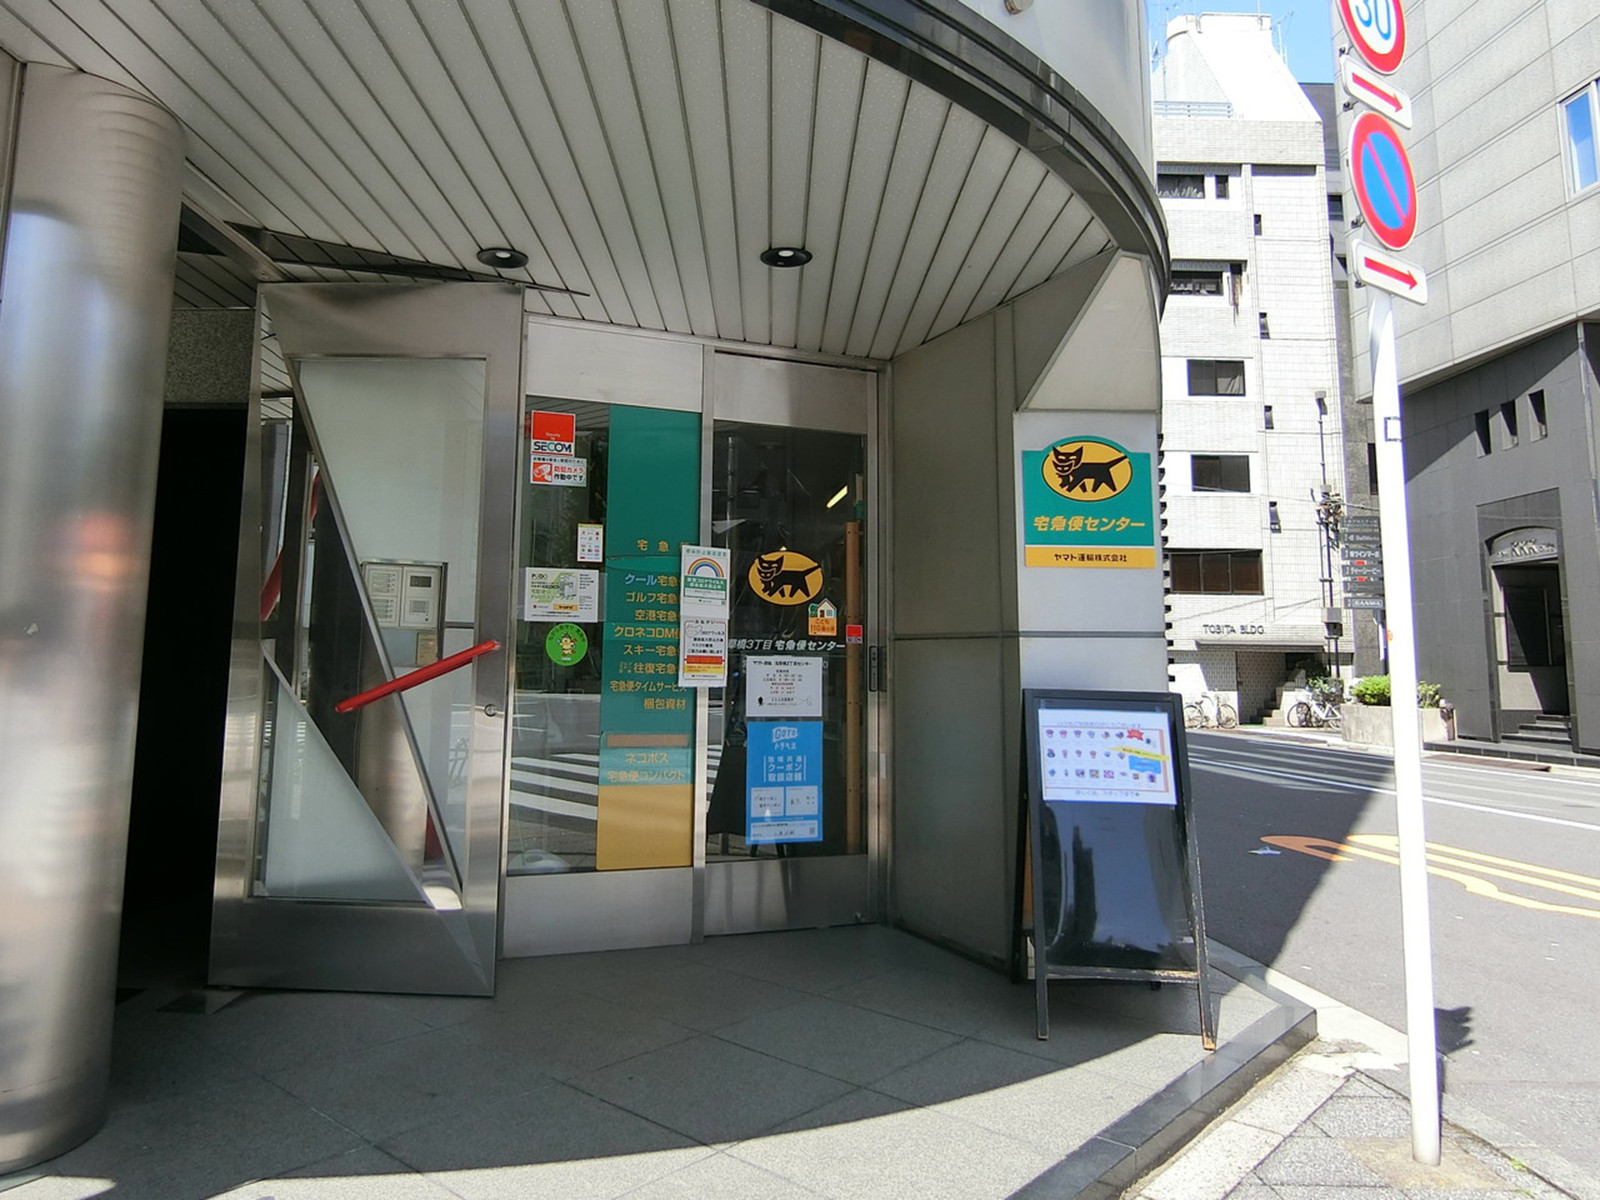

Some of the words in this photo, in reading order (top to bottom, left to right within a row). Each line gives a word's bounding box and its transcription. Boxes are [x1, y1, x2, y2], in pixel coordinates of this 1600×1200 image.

[533, 441, 572, 453] SECOM
[1034, 515, 1145, 531] 宅急便センター
[1054, 553, 1127, 563] ヤマト運輸株式会社
[625, 574, 680, 587] クール宅急
[626, 592, 680, 604] ゴルフ宅急
[635, 609, 680, 621] 空港宅急
[1203, 624, 1236, 635] TOBITA
[624, 644, 680, 657] スキー宅急
[775, 640, 845, 651] 宅急便センター
[634, 662, 680, 675] 往復宅急
[644, 698, 686, 710] 梱包資材
[625, 752, 669, 764] ネコポス
[768, 764, 802, 772] クーポン
[608, 769, 686, 783] 宅急便コンパクト
